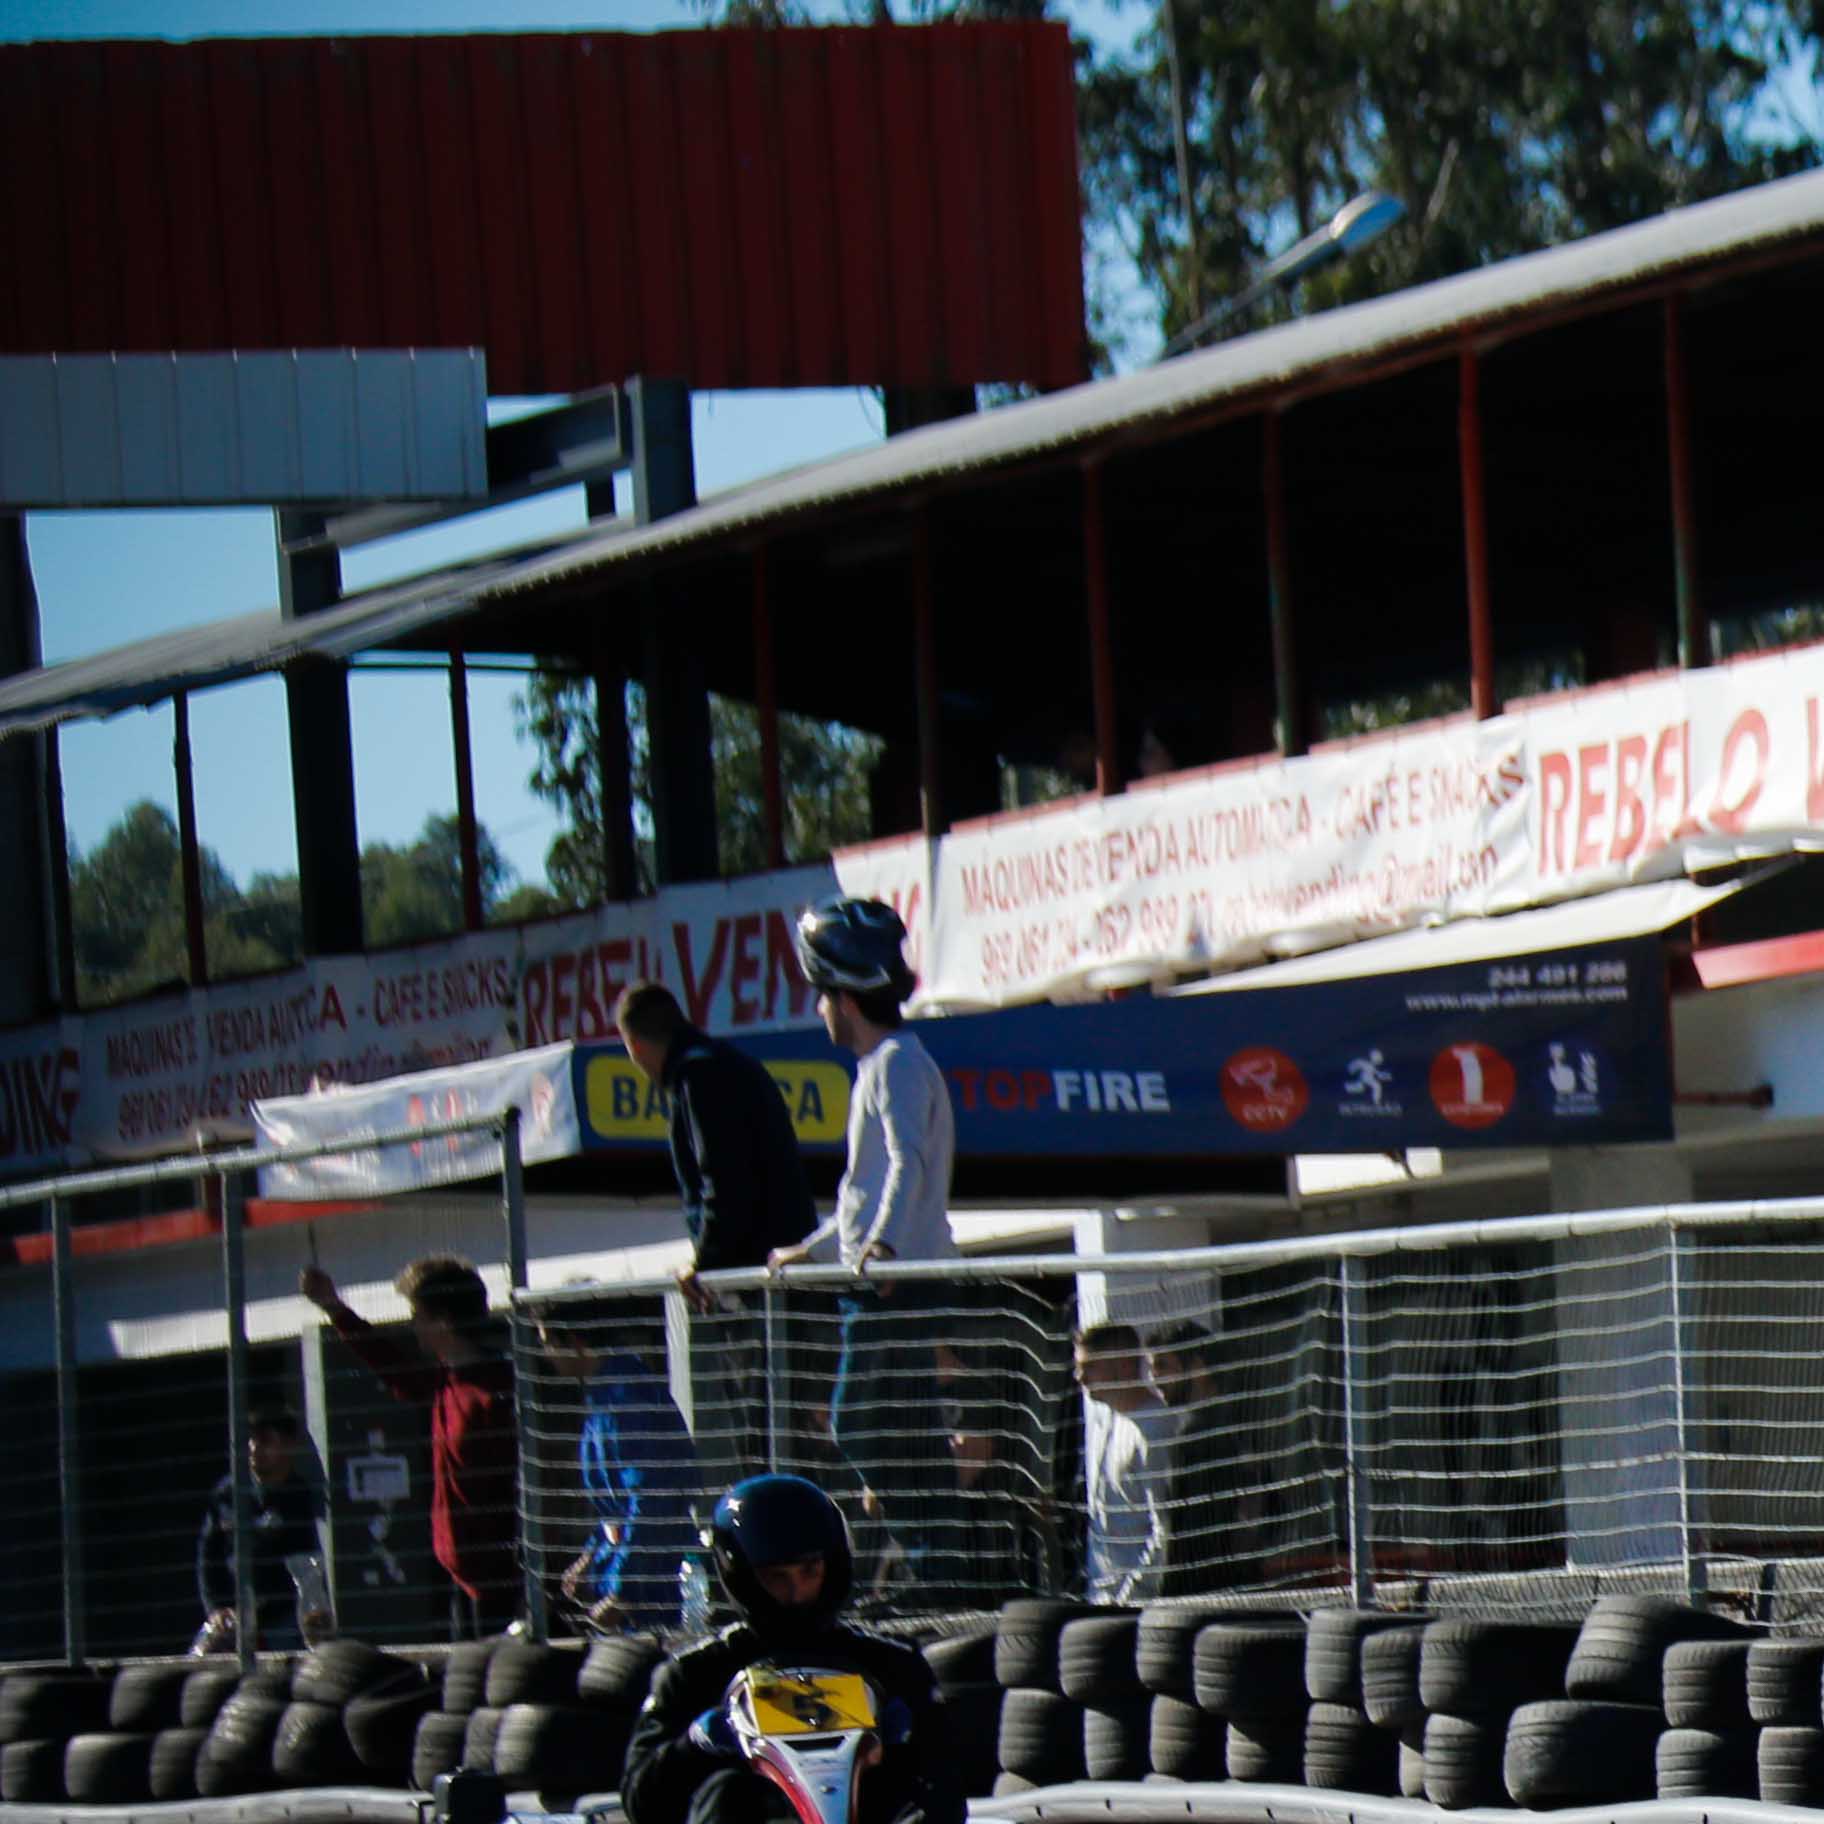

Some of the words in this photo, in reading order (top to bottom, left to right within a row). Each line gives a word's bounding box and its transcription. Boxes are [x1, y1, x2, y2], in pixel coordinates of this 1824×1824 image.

[1408, 769, 1422, 828] E
[1537, 708, 1771, 878] REBELO
[953, 1069, 1172, 1114] TOPFIRE
[1242, 1103, 1290, 1122] CCTV
